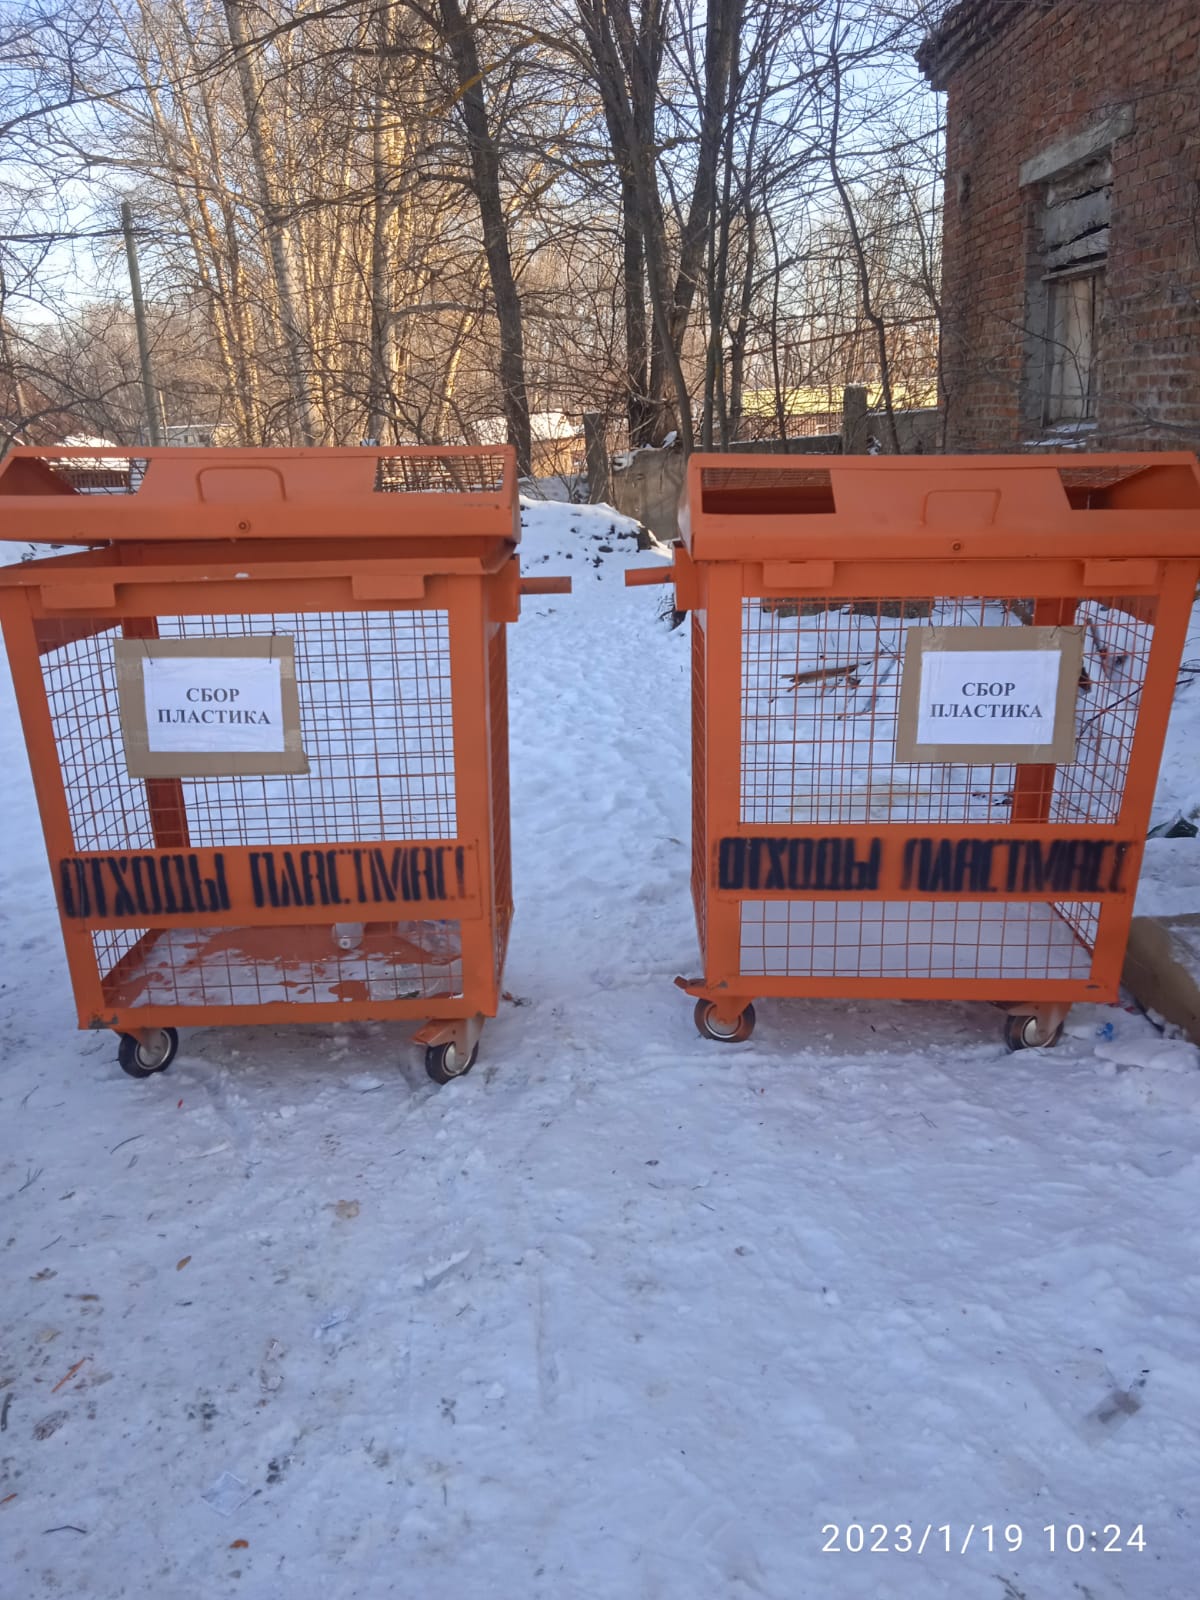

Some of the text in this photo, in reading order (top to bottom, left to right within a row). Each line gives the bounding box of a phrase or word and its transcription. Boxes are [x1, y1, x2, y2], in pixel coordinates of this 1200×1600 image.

[186, 687, 240, 703] СБОР
[961, 682, 1016, 697] СБОР
[158, 709, 271, 725] ПЛАСТИКА
[930, 703, 1043, 718] ПЛАСТИКА
[717, 837, 1132, 893] ОТХОДЫ ПЛАСТМАСС
[61, 853, 230, 918] ОТХОДЫ
